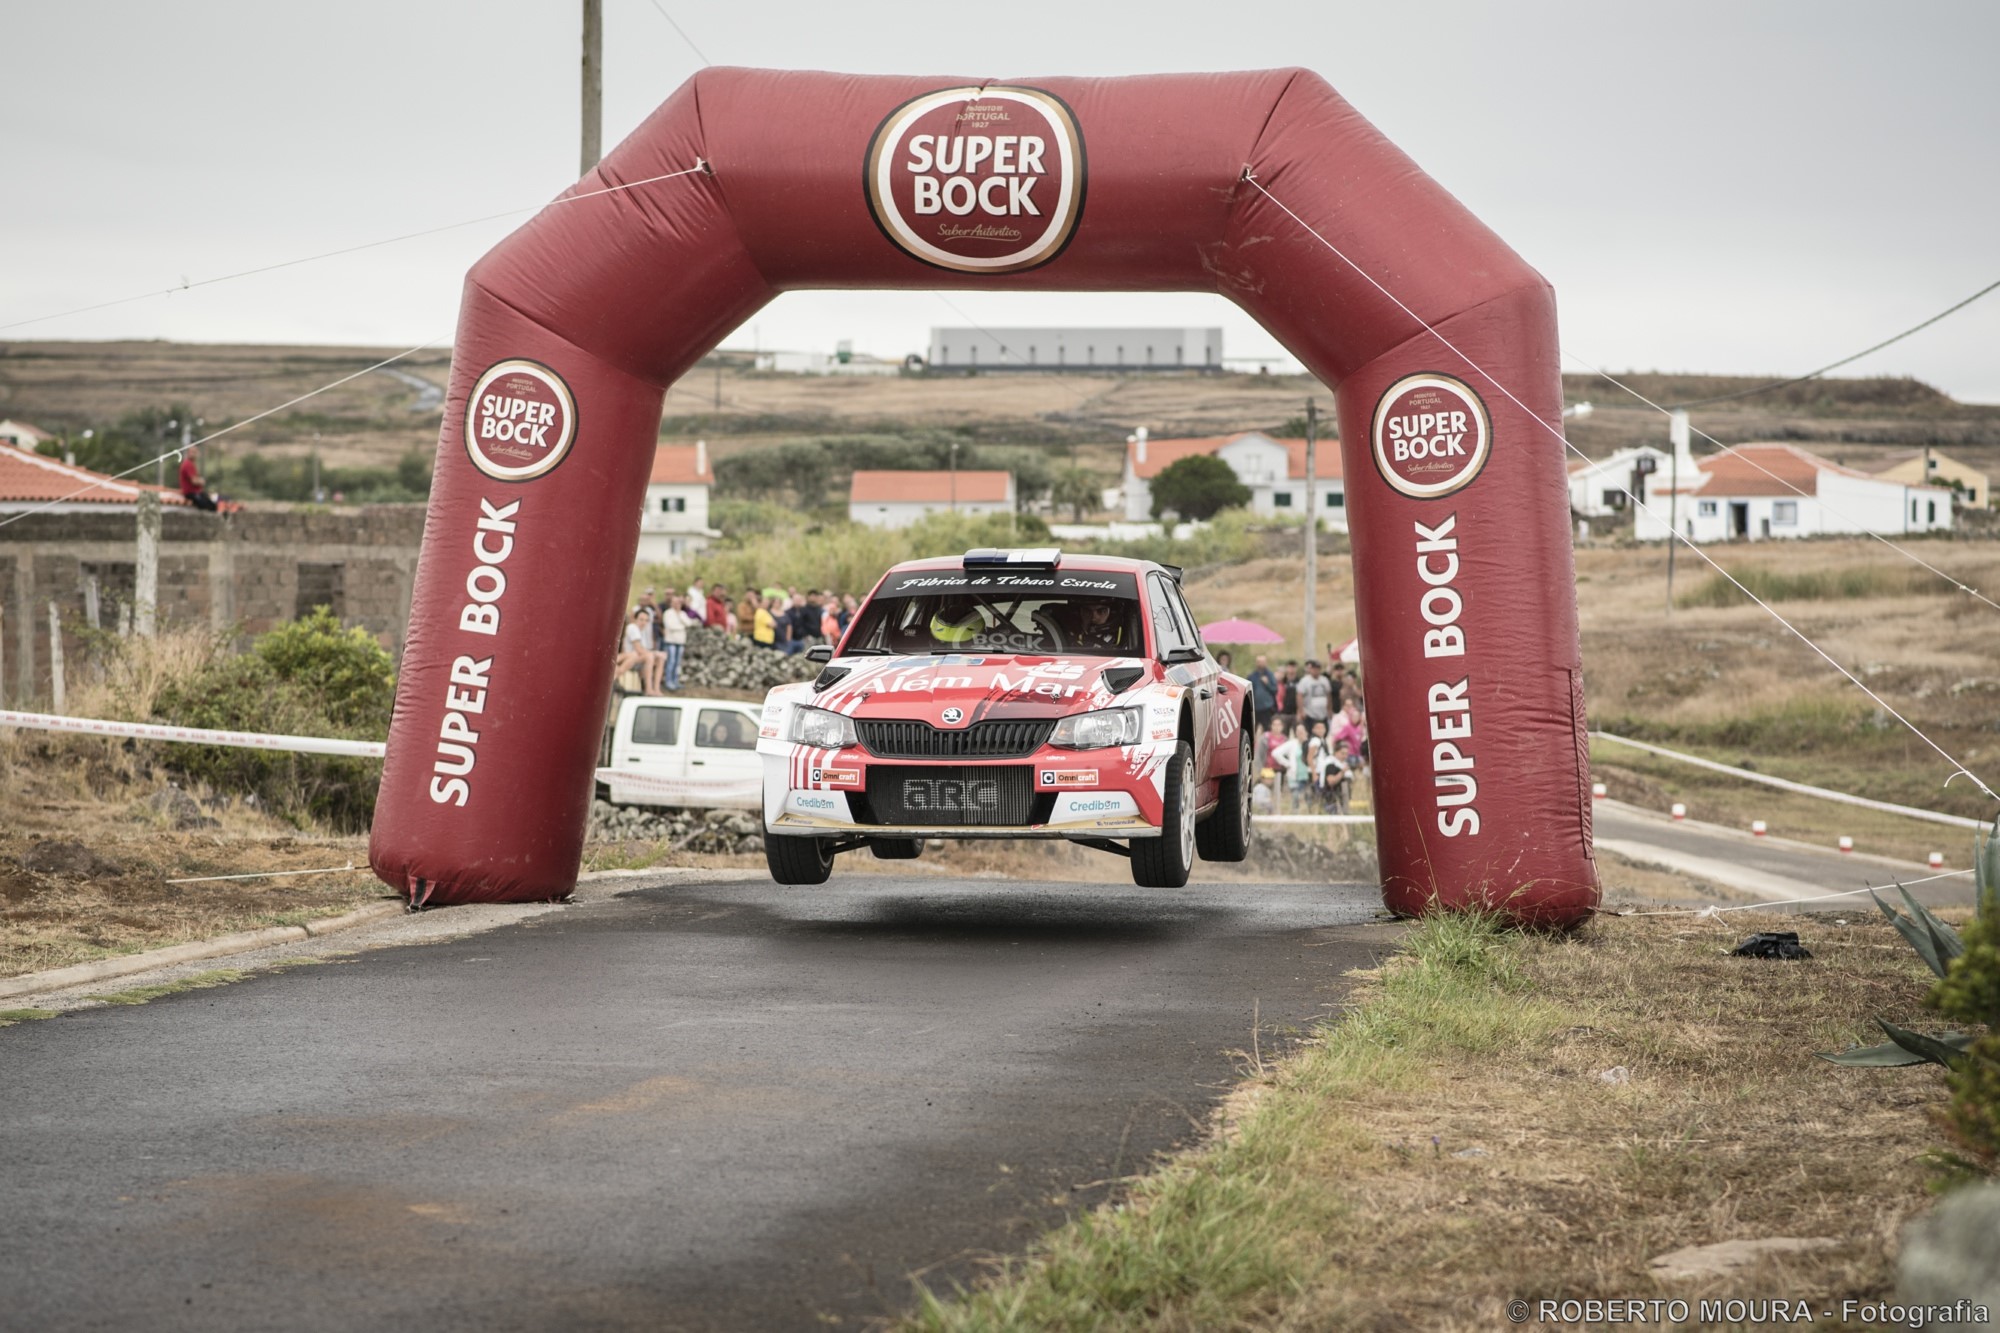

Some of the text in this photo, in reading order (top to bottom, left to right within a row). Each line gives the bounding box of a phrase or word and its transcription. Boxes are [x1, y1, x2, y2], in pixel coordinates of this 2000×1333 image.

[956, 112, 1010, 121] PORTUGAL
[907, 134, 1046, 174] SUPER
[914, 176, 1041, 216] BOCK
[481, 394, 556, 426] SUPER
[481, 417, 549, 447] BOCK
[1388, 410, 1468, 439] SUPER
[1393, 433, 1467, 461] BOCK
[459, 498, 521, 636] BOCK
[971, 576, 990, 585] de
[996, 576, 1054, 586] Tabaco
[1060, 577, 1117, 590] Estrela
[852, 672, 1084, 699] Além Mar
[1414, 513, 1480, 838] SUPER BOCK
[429, 655, 492, 807] SUPER
[823, 772, 856, 781] Omnicraft
[1058, 774, 1096, 782] Omnicraft
[796, 796, 835, 809] Credibom
[1069, 800, 1121, 812] Credibom
